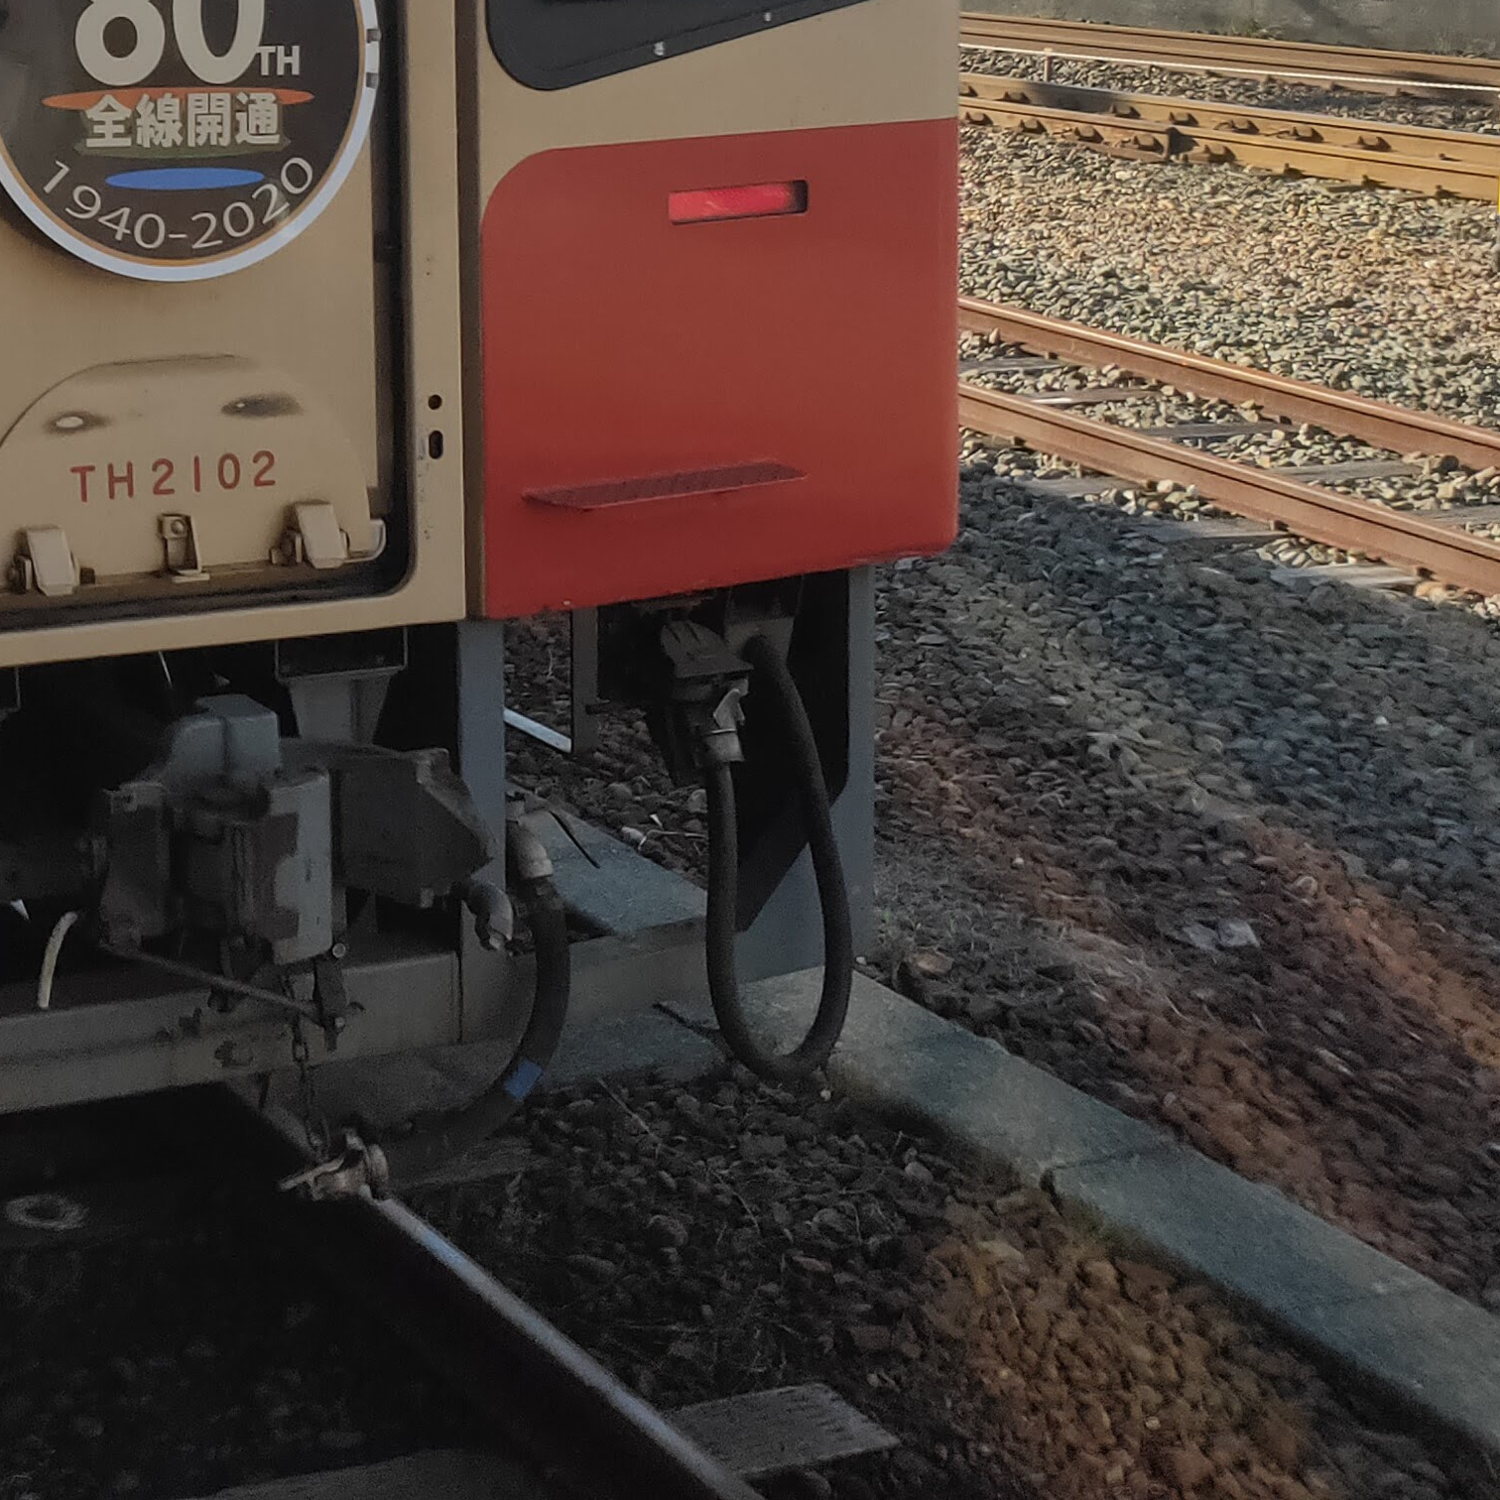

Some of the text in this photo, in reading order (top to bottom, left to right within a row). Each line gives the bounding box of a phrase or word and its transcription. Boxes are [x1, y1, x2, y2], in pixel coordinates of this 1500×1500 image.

[85, 92, 281, 148] 全線開通
[43, 157, 314, 250] 1940-2020
[71, 451, 276, 502] TH2102
